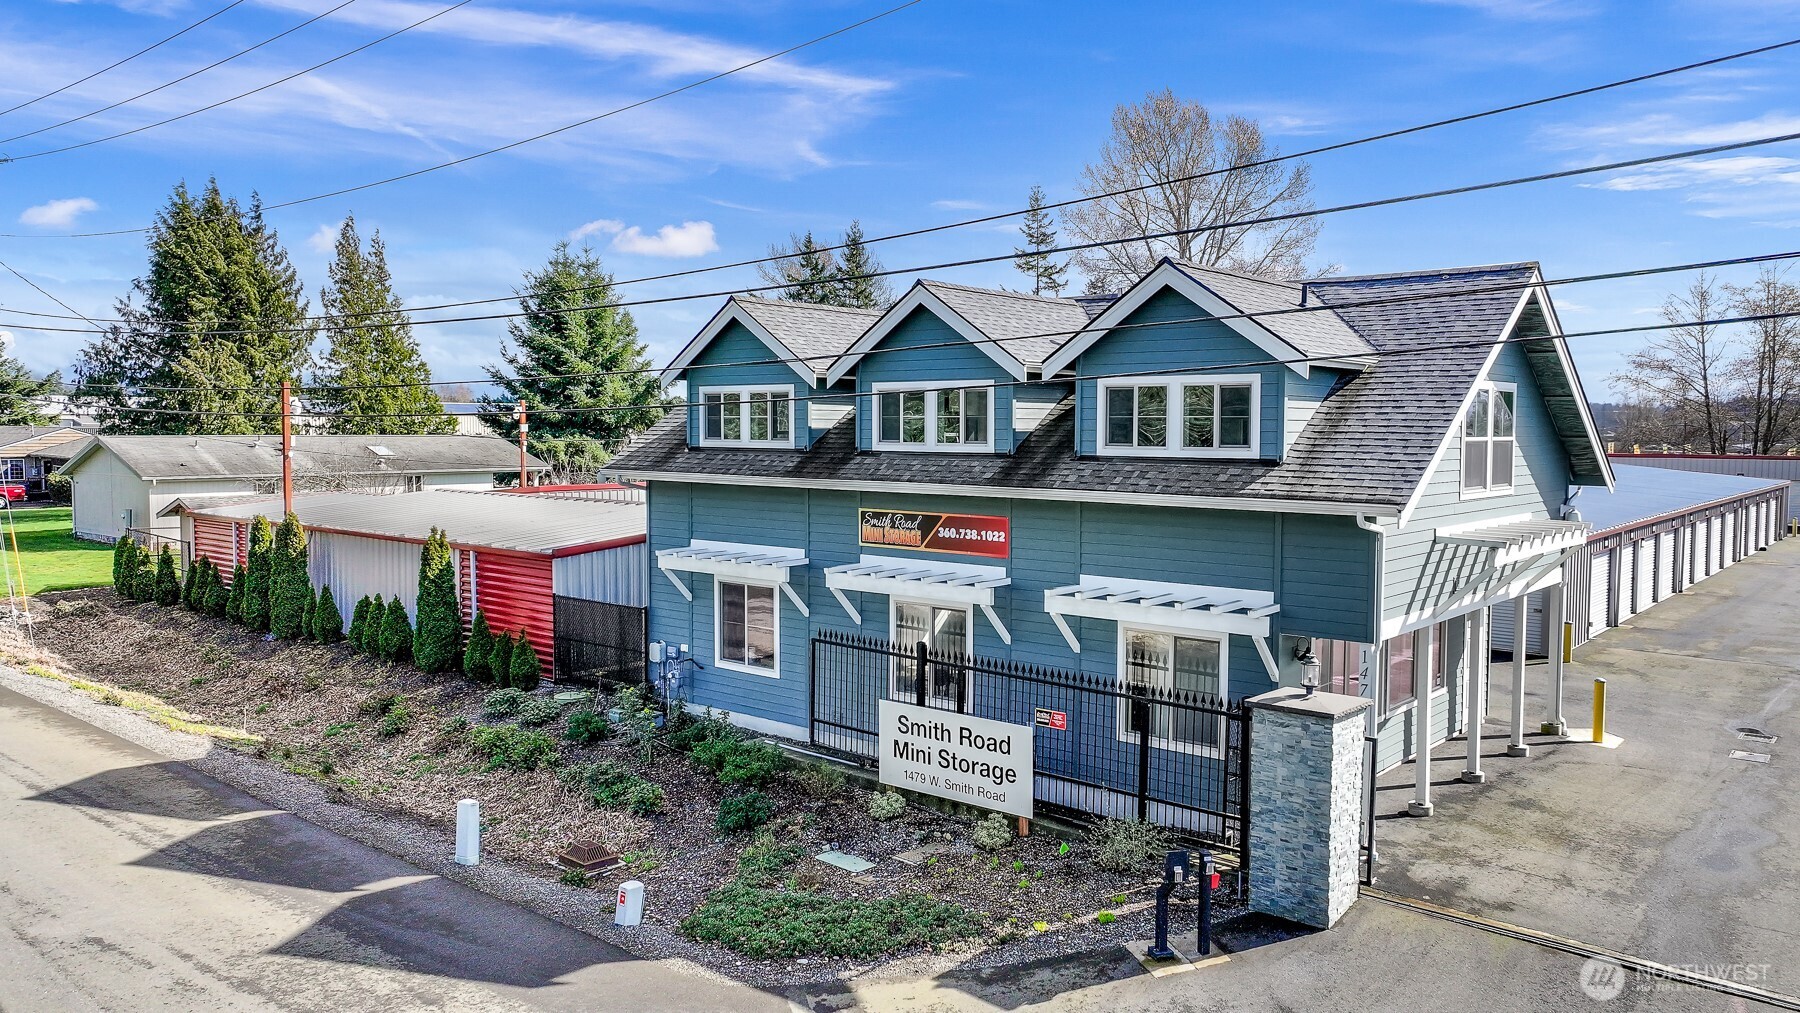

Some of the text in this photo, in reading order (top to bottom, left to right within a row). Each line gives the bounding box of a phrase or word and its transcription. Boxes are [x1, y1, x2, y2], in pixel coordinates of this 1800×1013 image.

[862, 524, 922, 546] MINI STORAGE
[863, 512, 922, 531] Smith Road
[937, 526, 1006, 543] 360.738.1022
[897, 714, 1011, 755] Smith Road
[893, 739, 1017, 785] Mini Storage
[904, 770, 1006, 803] 1479 W. Smith Road
